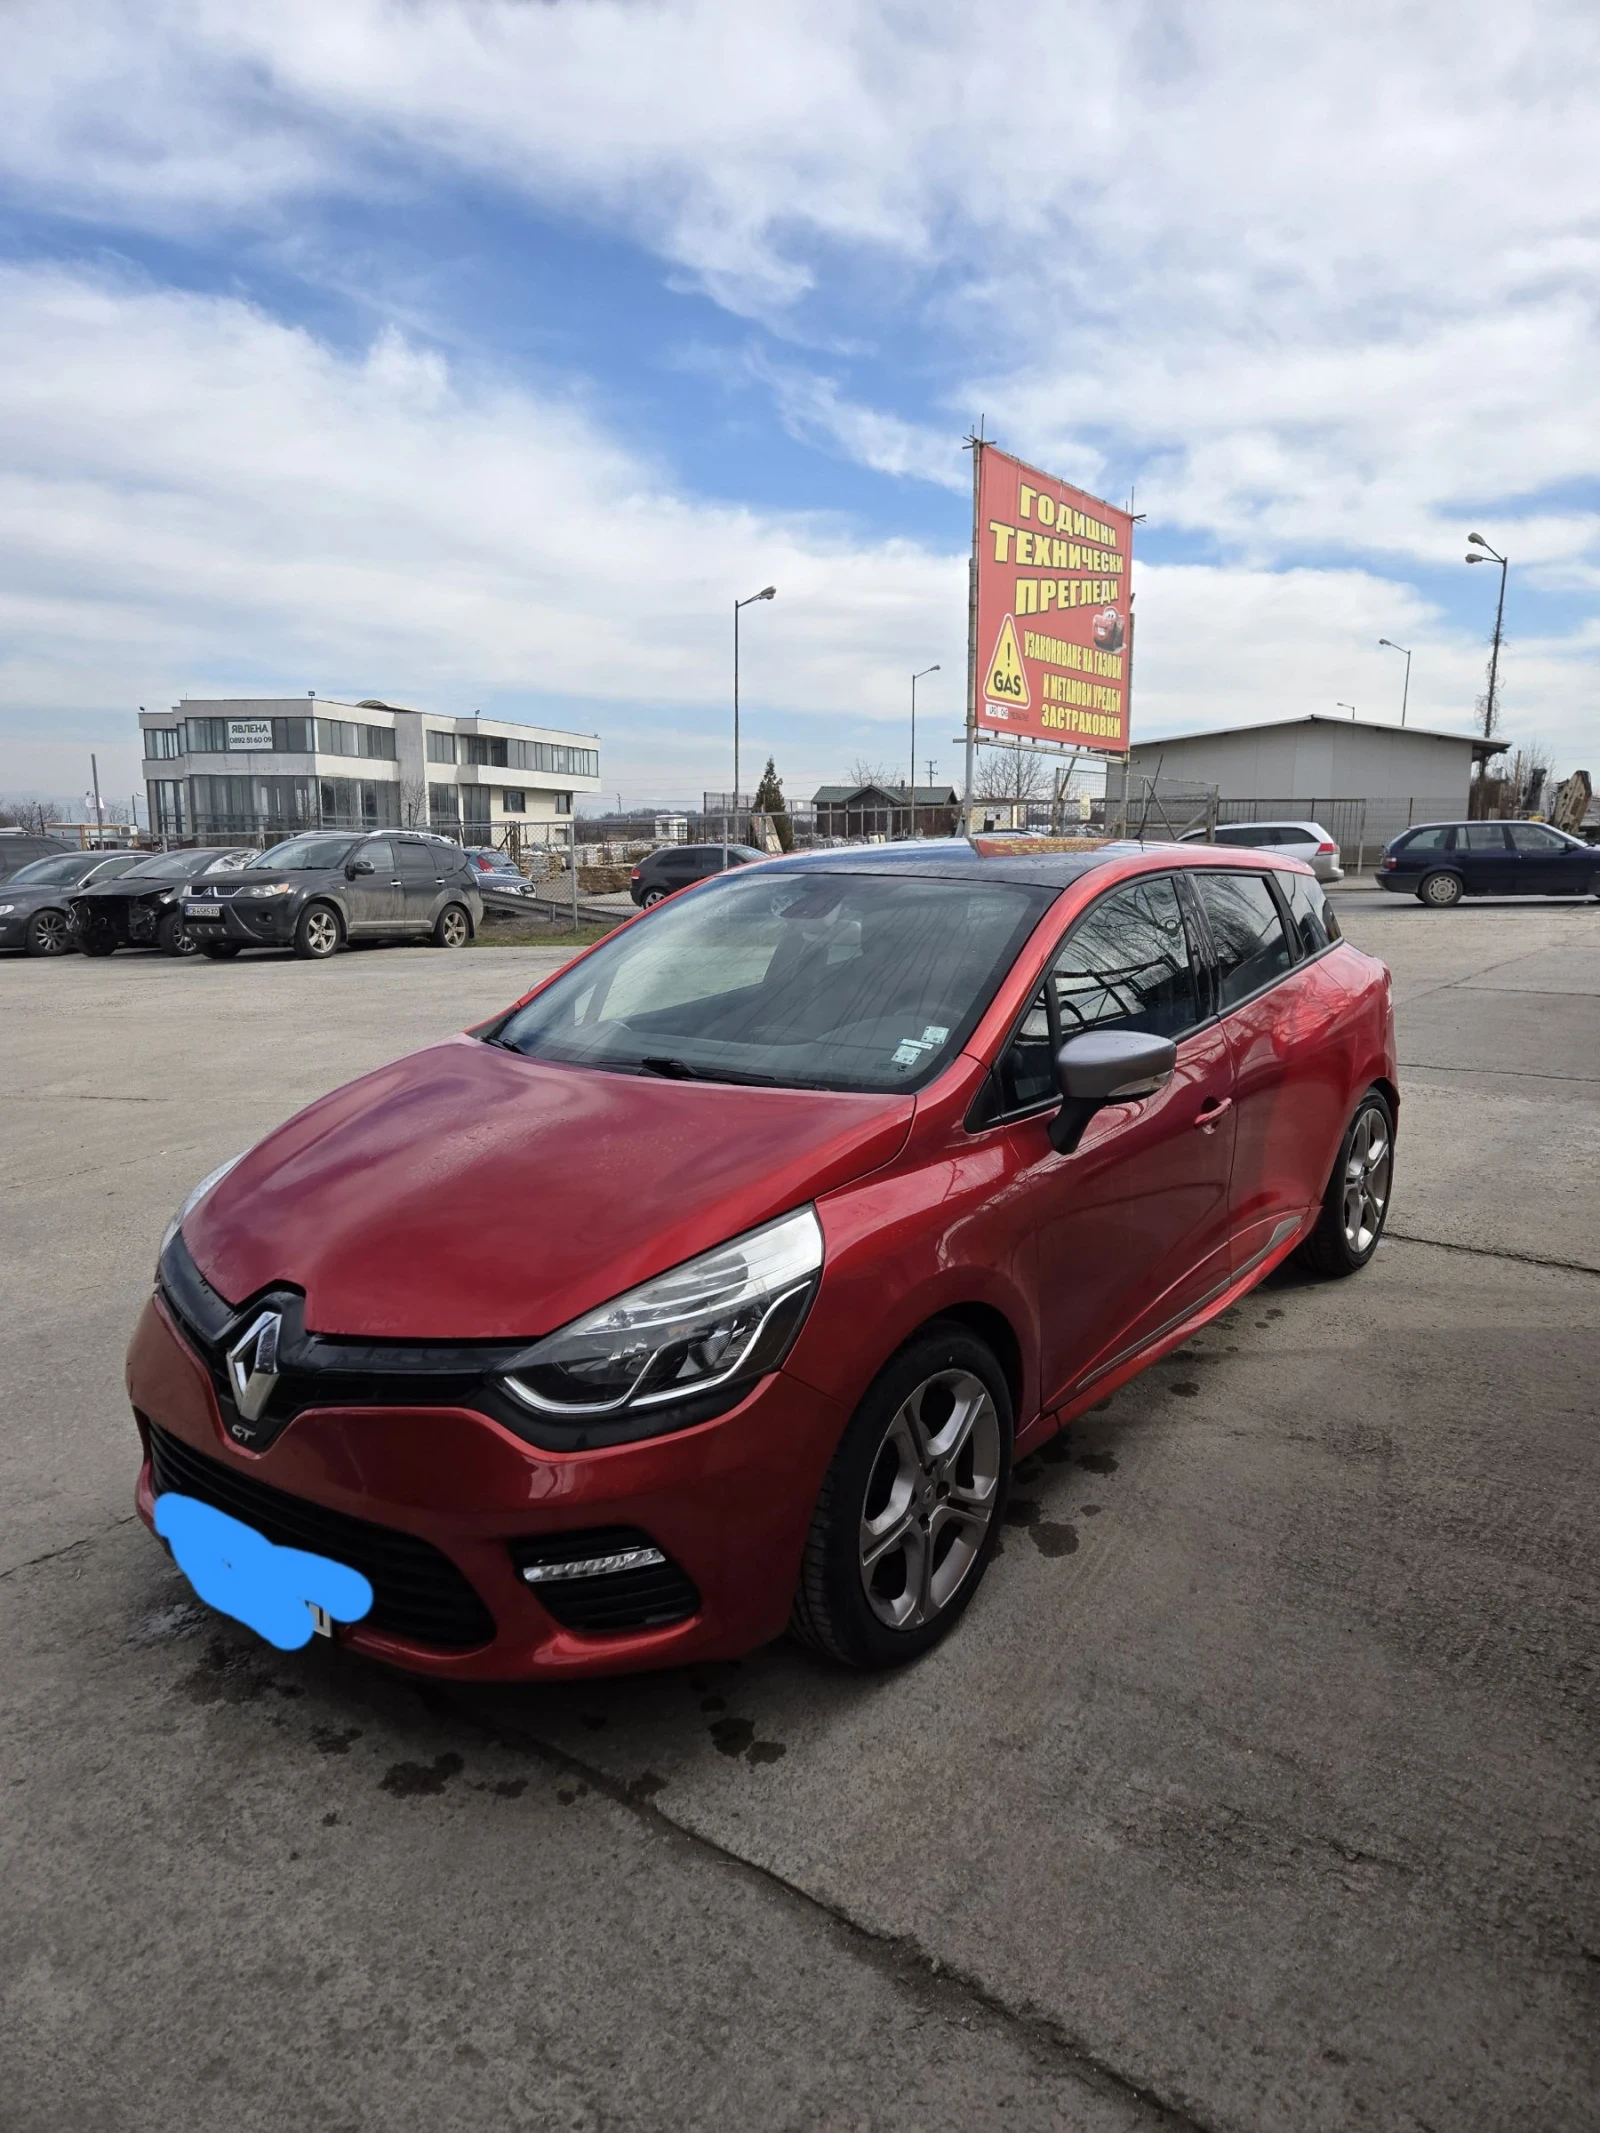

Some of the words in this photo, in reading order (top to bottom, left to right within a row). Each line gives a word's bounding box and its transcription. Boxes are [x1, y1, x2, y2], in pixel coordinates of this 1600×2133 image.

[1019, 483, 1117, 548] ГОДИШНИ
[989, 519, 1123, 574] ТЕХНИЧЕСКИ
[1015, 577, 1118, 616] ПРЕГЛЕДИ
[1024, 630, 1082, 670] УЗАКОНЯВАНЕ
[1082, 646, 1094, 673] НА
[1094, 650, 1122, 680] ГАЗОВИ
[993, 669, 1021, 696] GAS
[1043, 672, 1050, 699] И
[1050, 674, 1092, 708] МЕТАНОВИ
[1093, 684, 1121, 714] УРЕДБИ
[231, 724, 269, 733] ЯВЛЕНА
[1041, 703, 1121, 739] ЗАСТРАХОВКИ
[231, 1424, 257, 1441] GT
